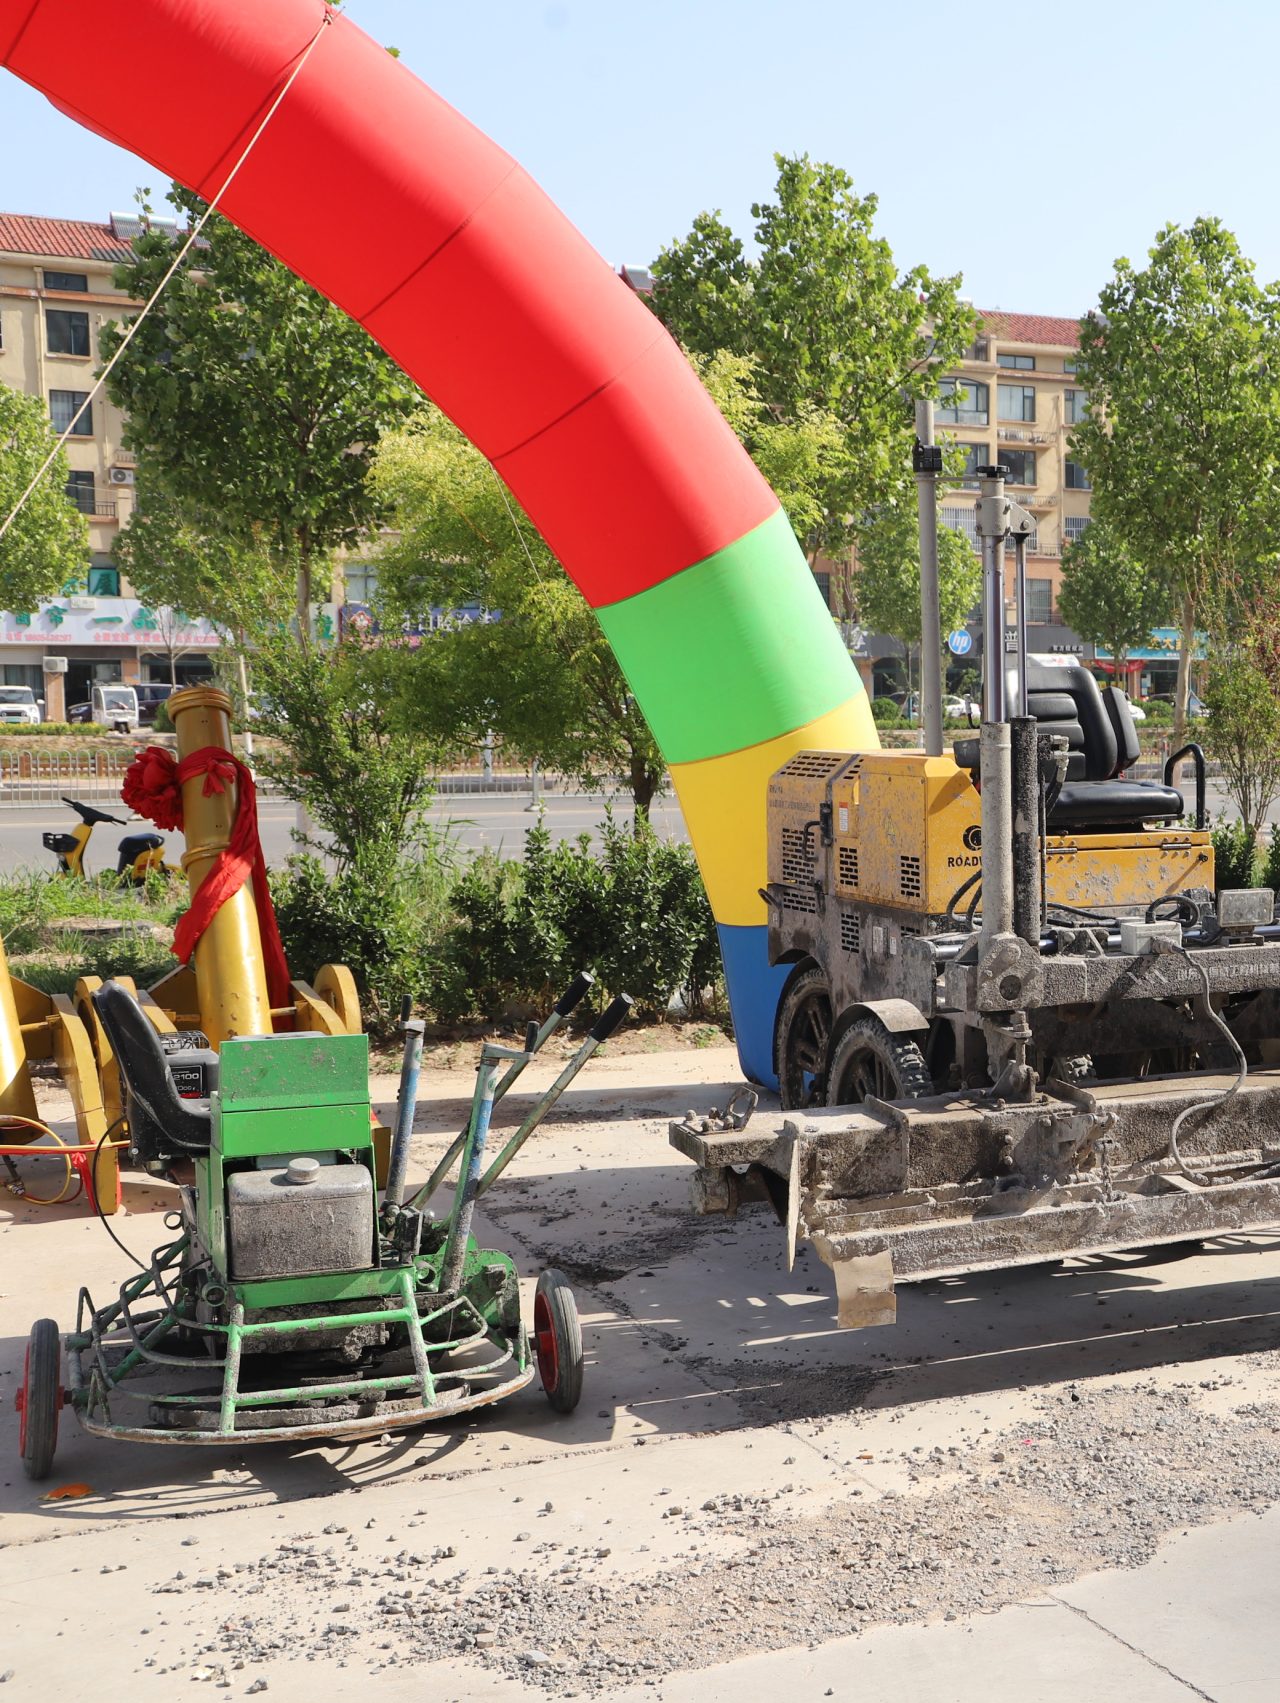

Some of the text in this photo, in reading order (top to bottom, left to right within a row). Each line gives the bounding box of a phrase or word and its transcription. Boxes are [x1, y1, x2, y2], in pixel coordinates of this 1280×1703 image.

[951, 632, 969, 656] hp
[947, 856, 982, 868] ROAD
[174, 1073, 199, 1081] 2100
